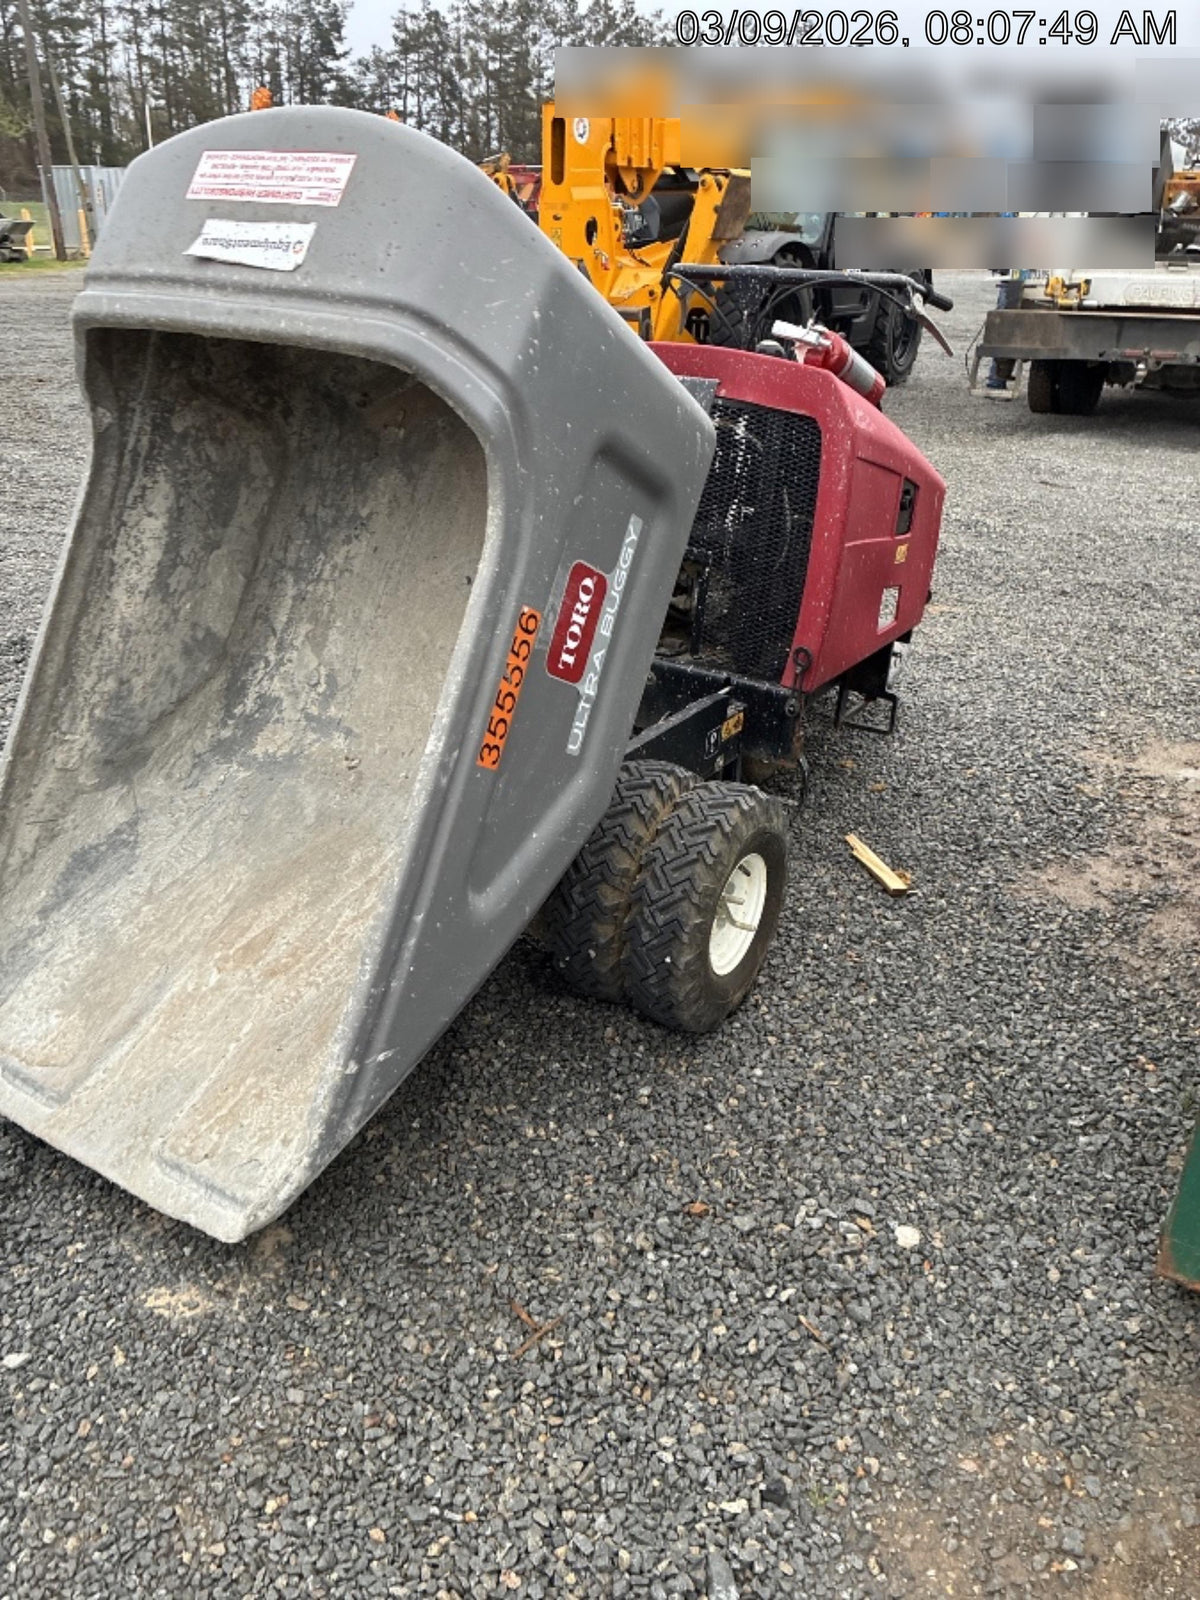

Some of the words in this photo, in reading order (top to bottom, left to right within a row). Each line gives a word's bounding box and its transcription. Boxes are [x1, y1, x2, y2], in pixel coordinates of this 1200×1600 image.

[479, 610, 539, 765] 355556
[557, 576, 596, 670] TORO
[567, 648, 606, 751] ULTRA
[600, 526, 639, 637] BUGGY
